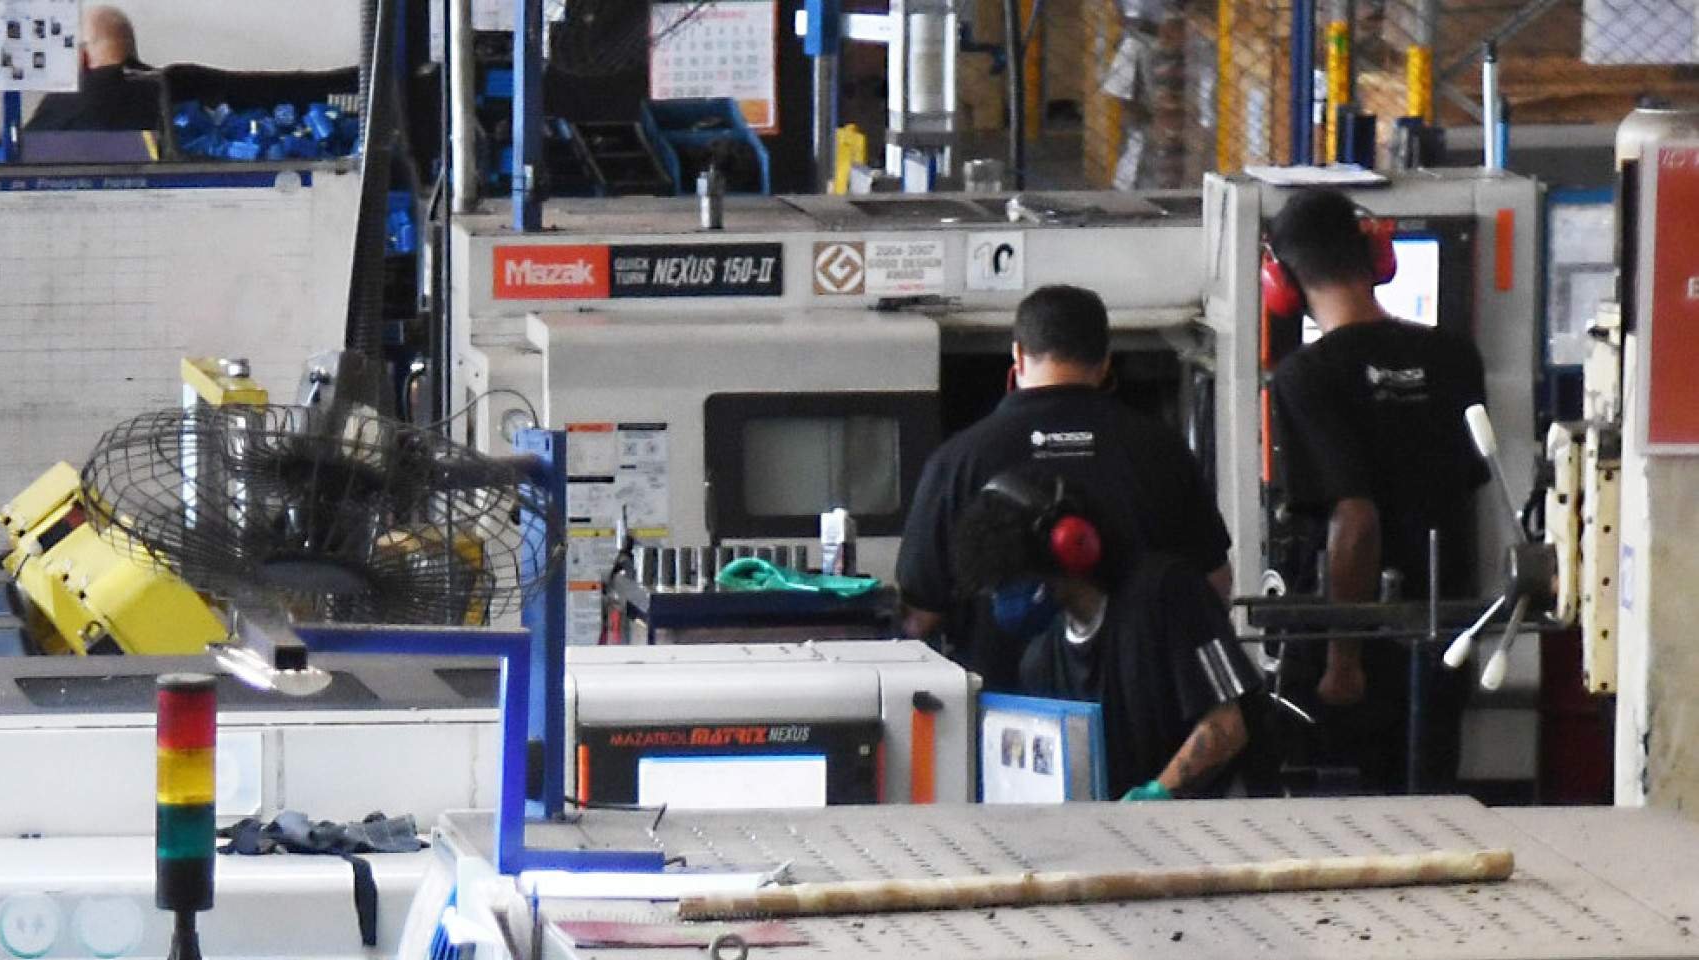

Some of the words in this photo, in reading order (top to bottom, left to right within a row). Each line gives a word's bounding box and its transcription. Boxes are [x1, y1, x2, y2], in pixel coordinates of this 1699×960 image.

[504, 259, 595, 286] Mazak
[653, 255, 716, 286] NEXUS
[609, 728, 687, 746] MAZATROL
[768, 724, 810, 743] NEXUS
